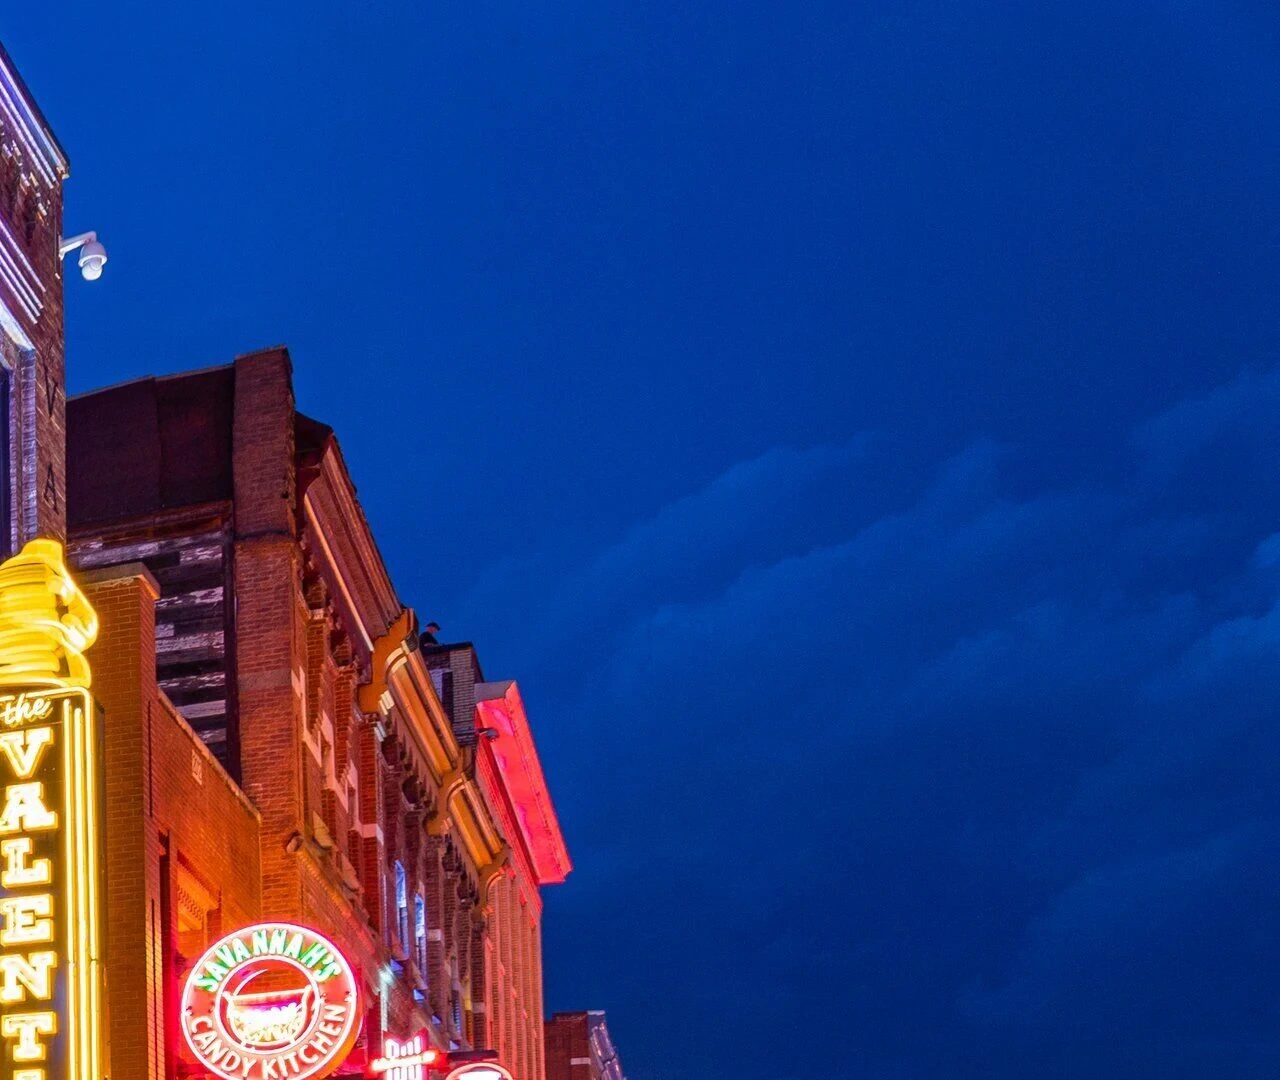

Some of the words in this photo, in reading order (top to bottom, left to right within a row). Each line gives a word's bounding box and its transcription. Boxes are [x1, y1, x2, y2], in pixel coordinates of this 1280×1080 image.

[0, 694, 54, 728] the
[193, 928, 342, 993] SAVANNAH'S
[190, 1014, 255, 1080] CANDY
[261, 1003, 348, 1080] KITCHEN
